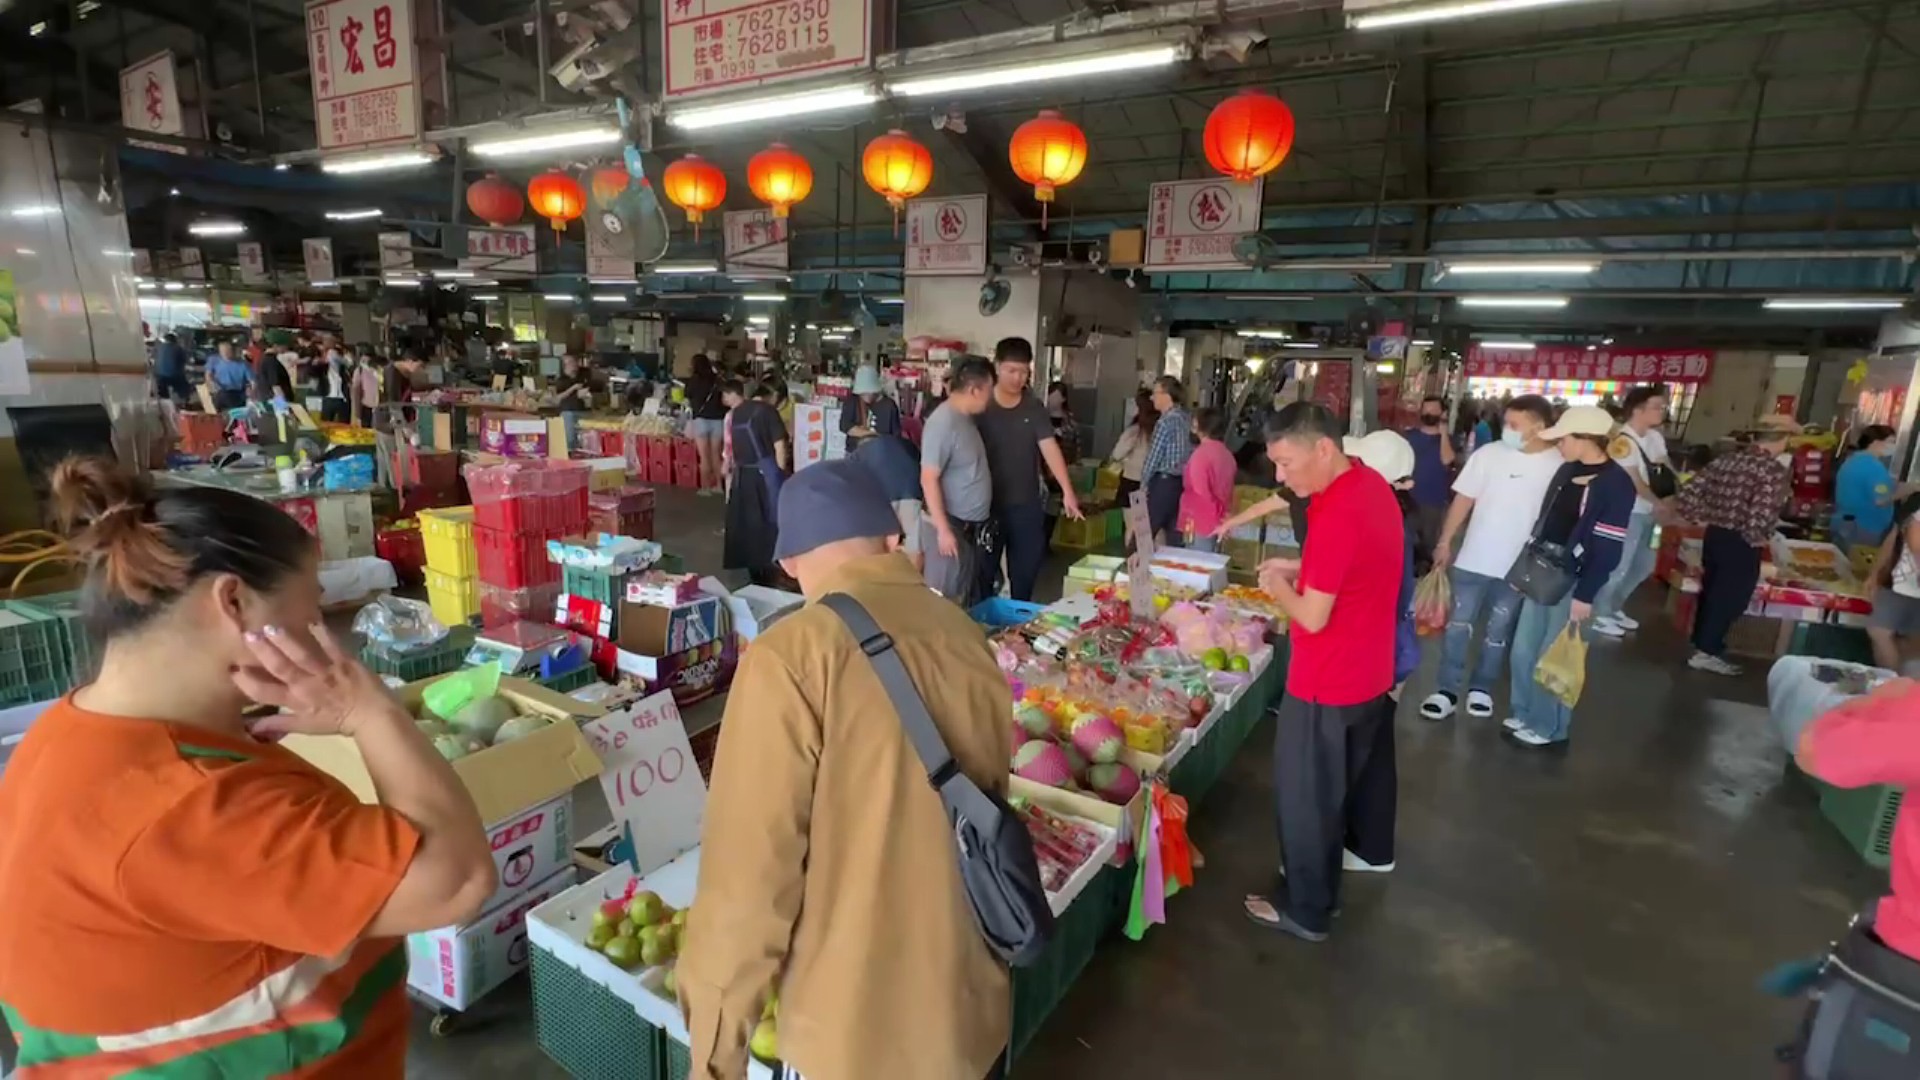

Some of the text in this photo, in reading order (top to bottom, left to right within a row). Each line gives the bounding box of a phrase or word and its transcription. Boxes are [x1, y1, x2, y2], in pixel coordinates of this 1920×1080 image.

[736, 0, 830, 36] 7627350
[340, 4, 397, 75] 宏昌
[737, 20, 830, 58] 7628115
[941, 207, 962, 236] 松
[1196, 190, 1225, 225] 松
[615, 746, 684, 807] 100
